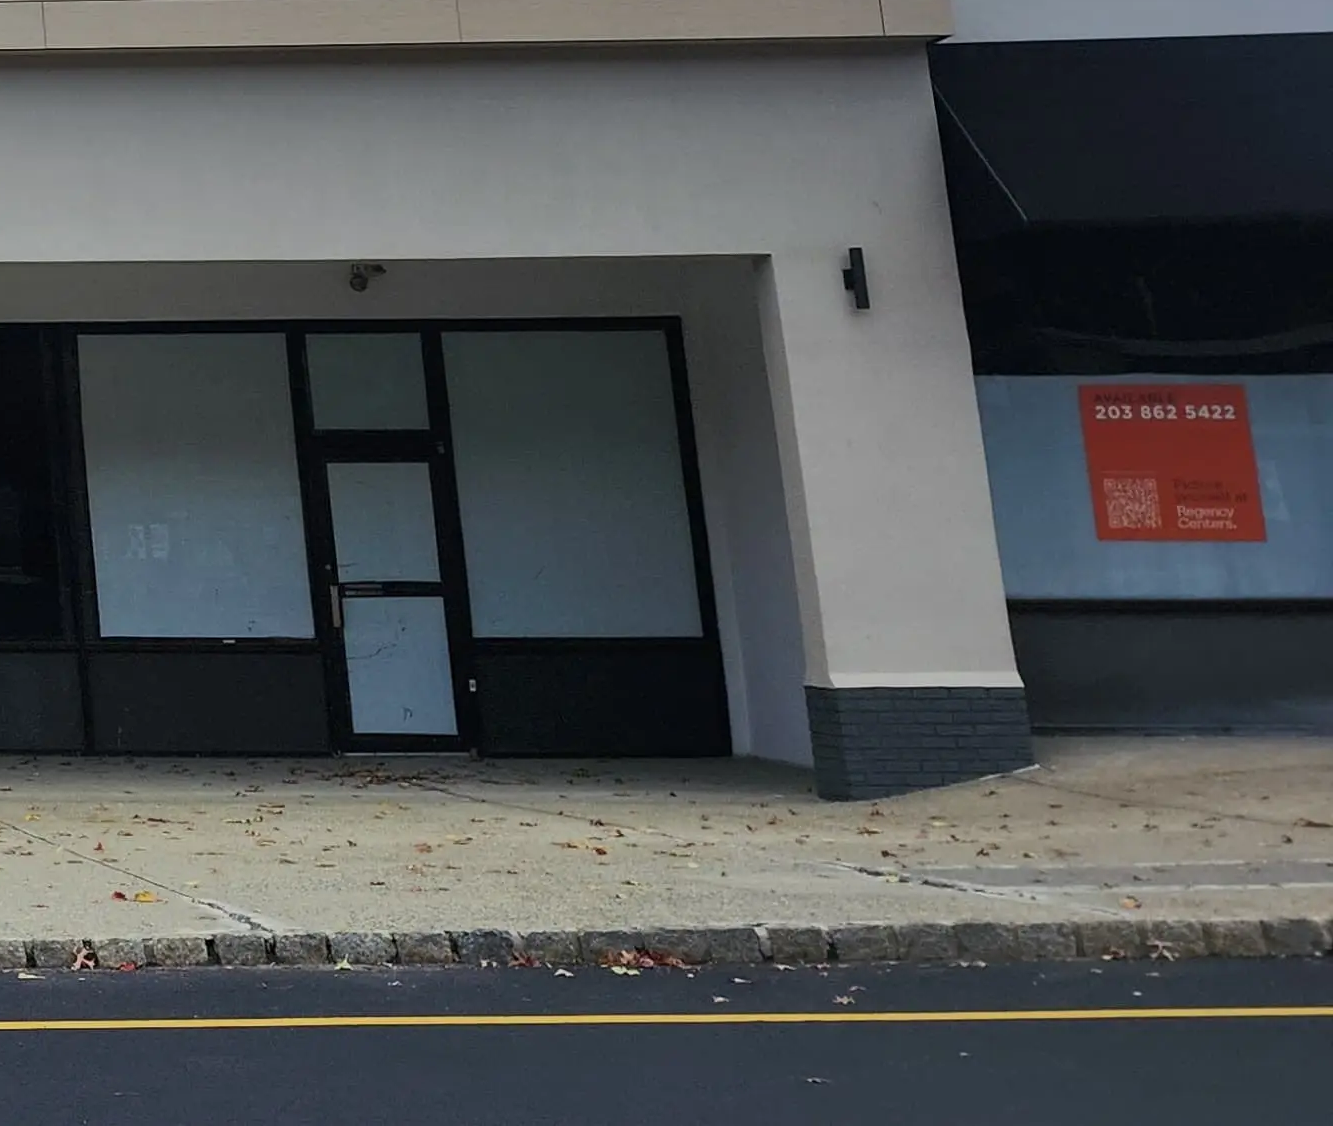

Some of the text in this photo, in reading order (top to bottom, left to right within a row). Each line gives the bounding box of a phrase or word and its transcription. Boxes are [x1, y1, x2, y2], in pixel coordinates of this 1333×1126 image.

[1094, 405, 1237, 420] 203 862 5422
[1176, 505, 1235, 519] Regency
[1177, 518, 1238, 530] Centers.
